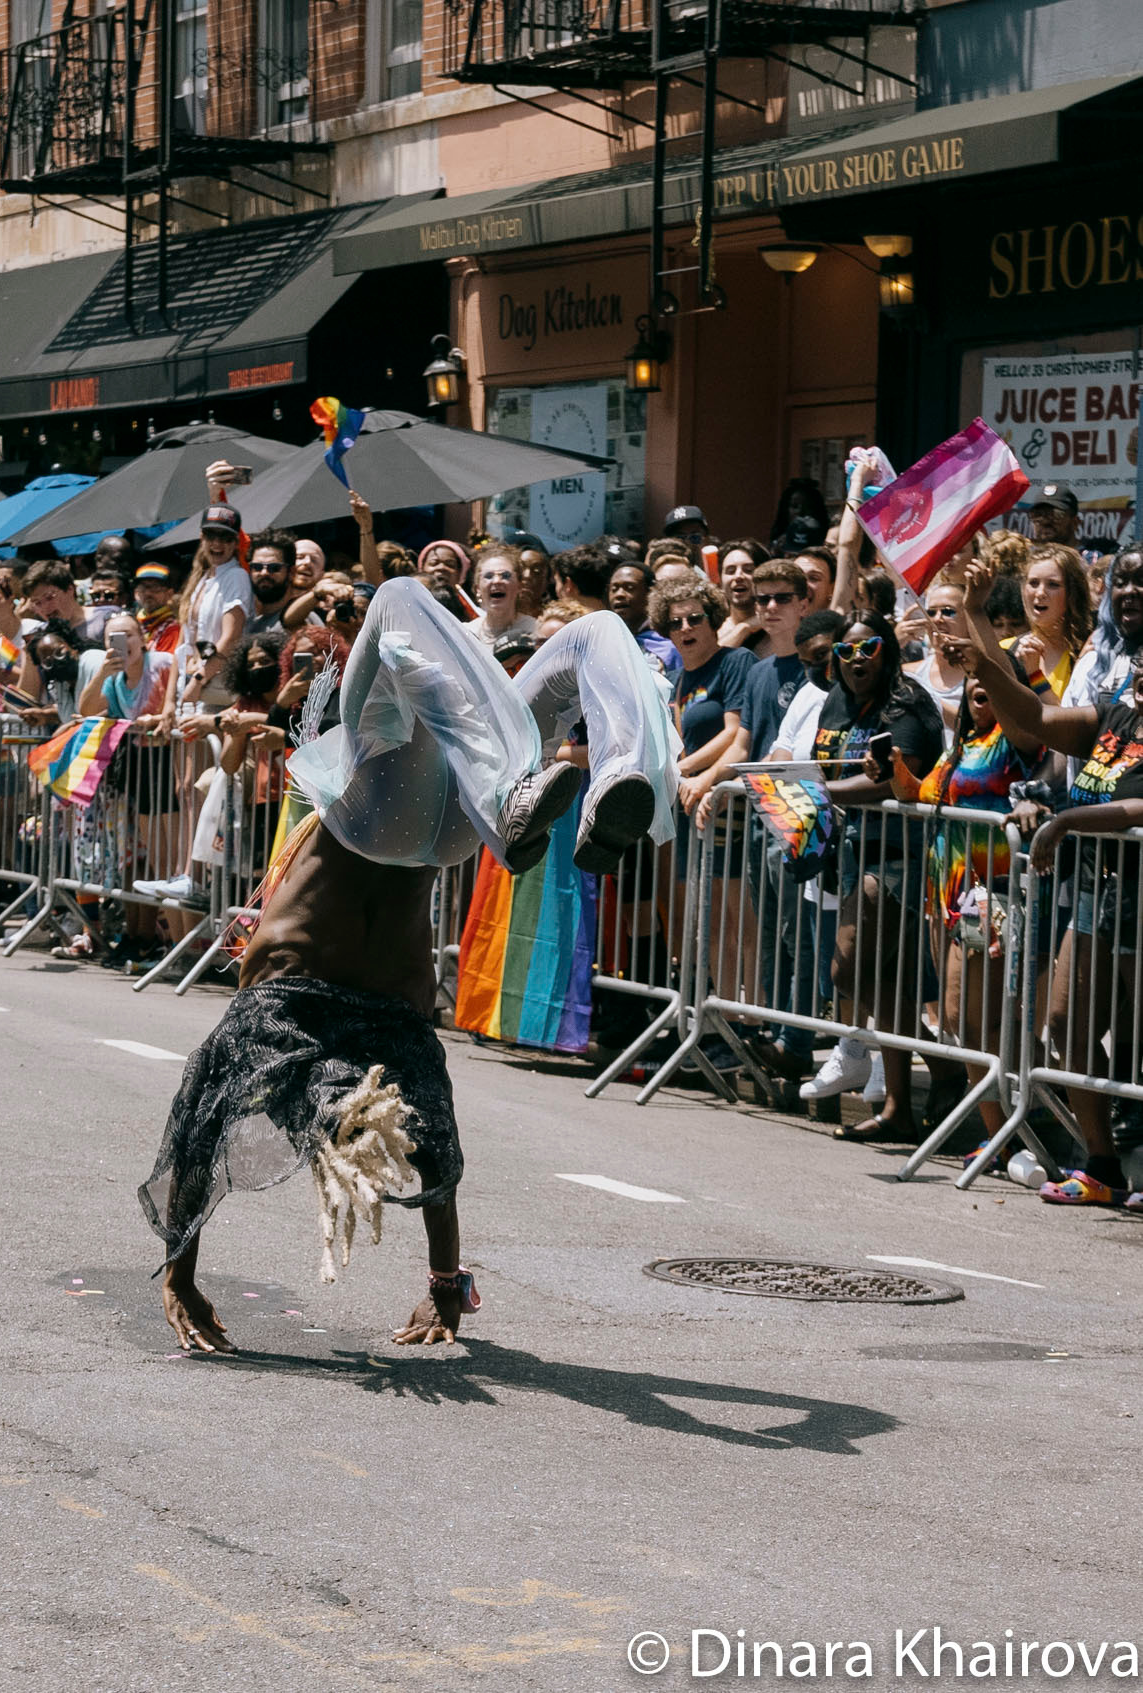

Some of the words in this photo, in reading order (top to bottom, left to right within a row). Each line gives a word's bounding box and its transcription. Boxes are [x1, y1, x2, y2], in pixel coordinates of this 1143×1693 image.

[713, 175, 746, 208] TEP
[783, 160, 839, 198] YOUR
[843, 149, 896, 188] SHOE
[902, 137, 965, 178] GAME
[419, 223, 455, 250] Malibu
[458, 219, 481, 249] Dog
[481, 214, 523, 241] Kitchen
[499, 293, 537, 350] Dog
[544, 281, 623, 337] Kitchen
[1046, 360, 1111, 376] CHRISTOPHER
[995, 387, 1077, 424] JUICE
[1021, 428, 1047, 468] &
[1051, 429, 1117, 466] DELI
[1074, 511, 1121, 540] SOON
